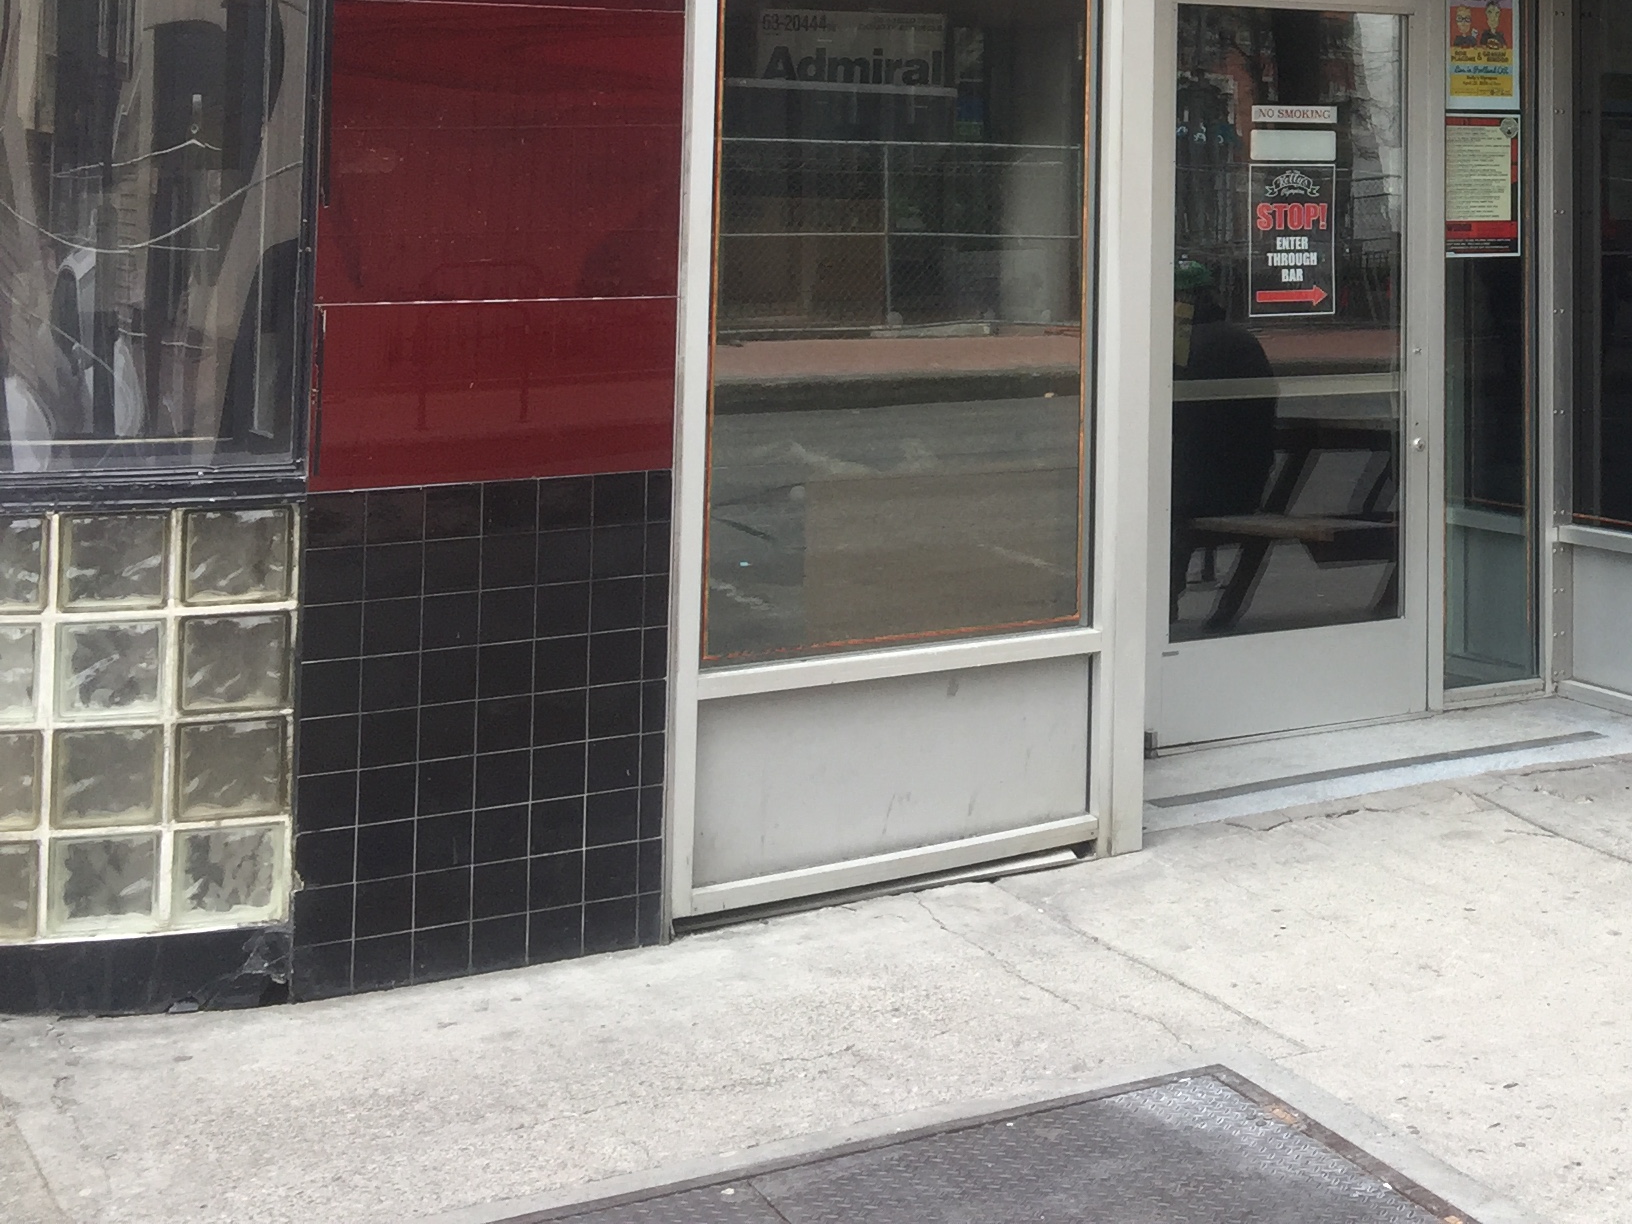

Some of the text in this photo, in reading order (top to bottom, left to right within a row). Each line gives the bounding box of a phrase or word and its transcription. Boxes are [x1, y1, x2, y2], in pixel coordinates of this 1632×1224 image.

[763, 45, 942, 86] Admiral
[1258, 108, 1331, 120] NO SMOKING
[1256, 202, 1328, 231] STOP!
[1276, 236, 1309, 250] ENTER
[1266, 252, 1318, 266] THROUGH
[1281, 268, 1304, 283] BAR
